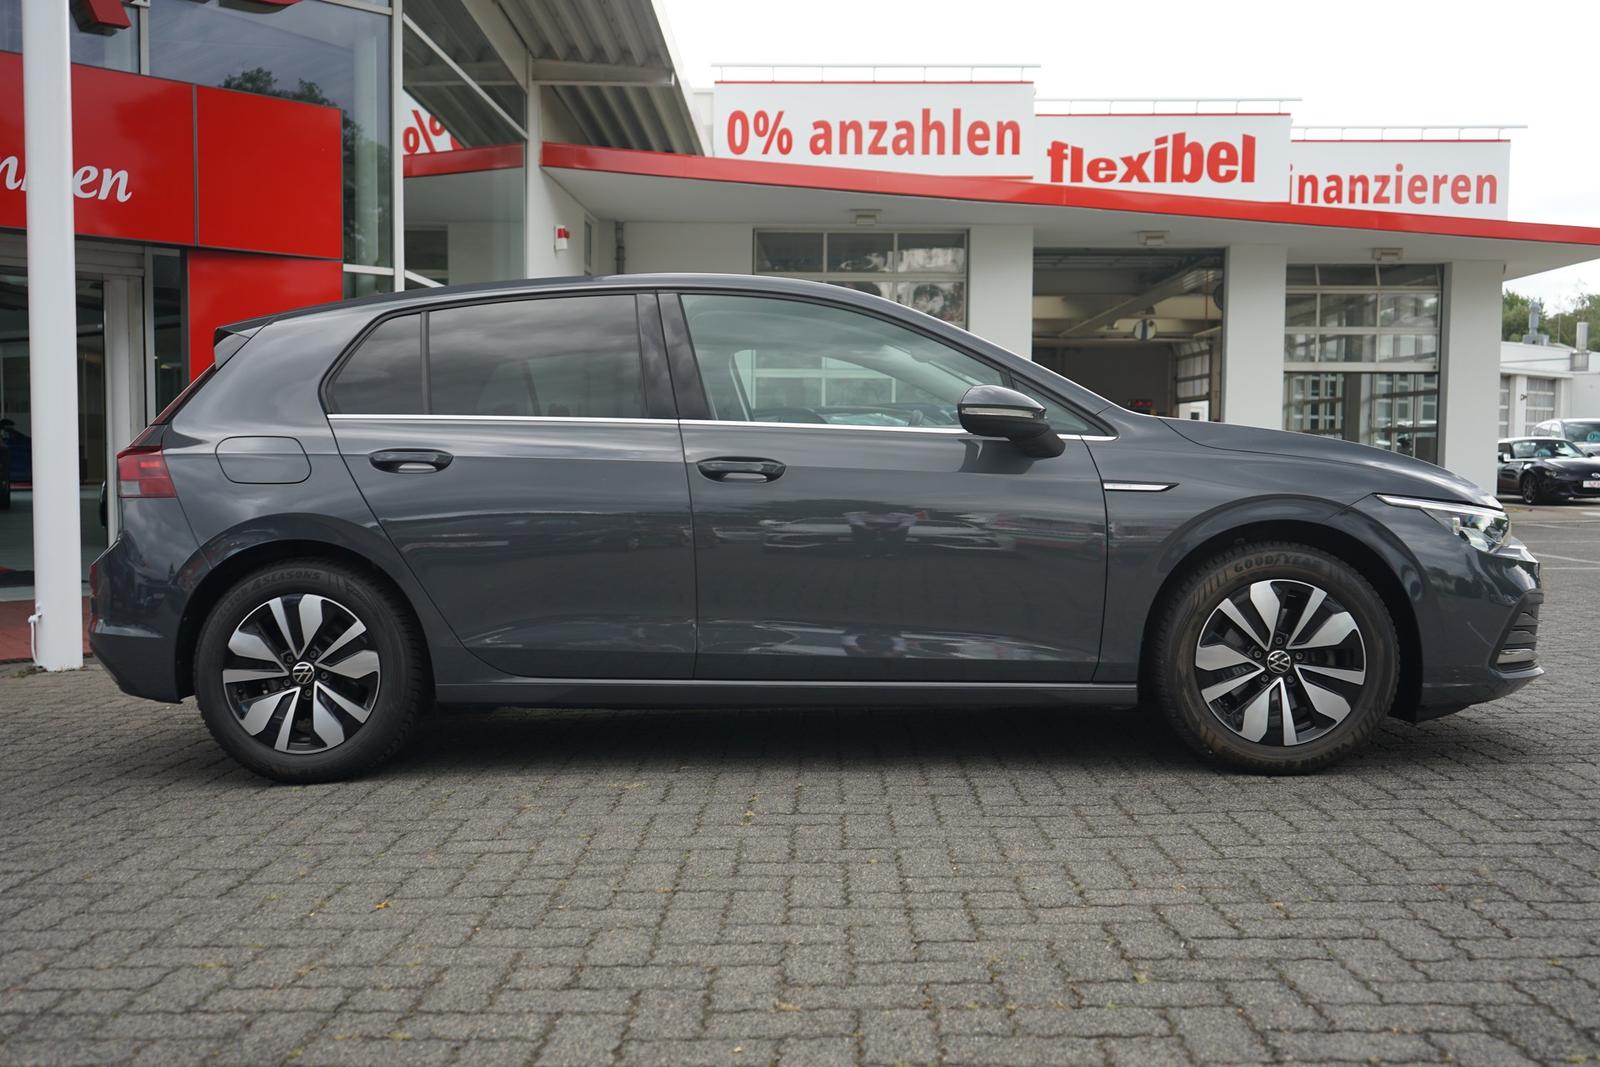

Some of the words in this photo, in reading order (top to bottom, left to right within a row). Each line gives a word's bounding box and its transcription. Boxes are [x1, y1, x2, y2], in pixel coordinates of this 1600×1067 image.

[726, 109, 794, 156] 0%
[808, 107, 1022, 157] anzahlen
[1048, 131, 1257, 186] flexibel
